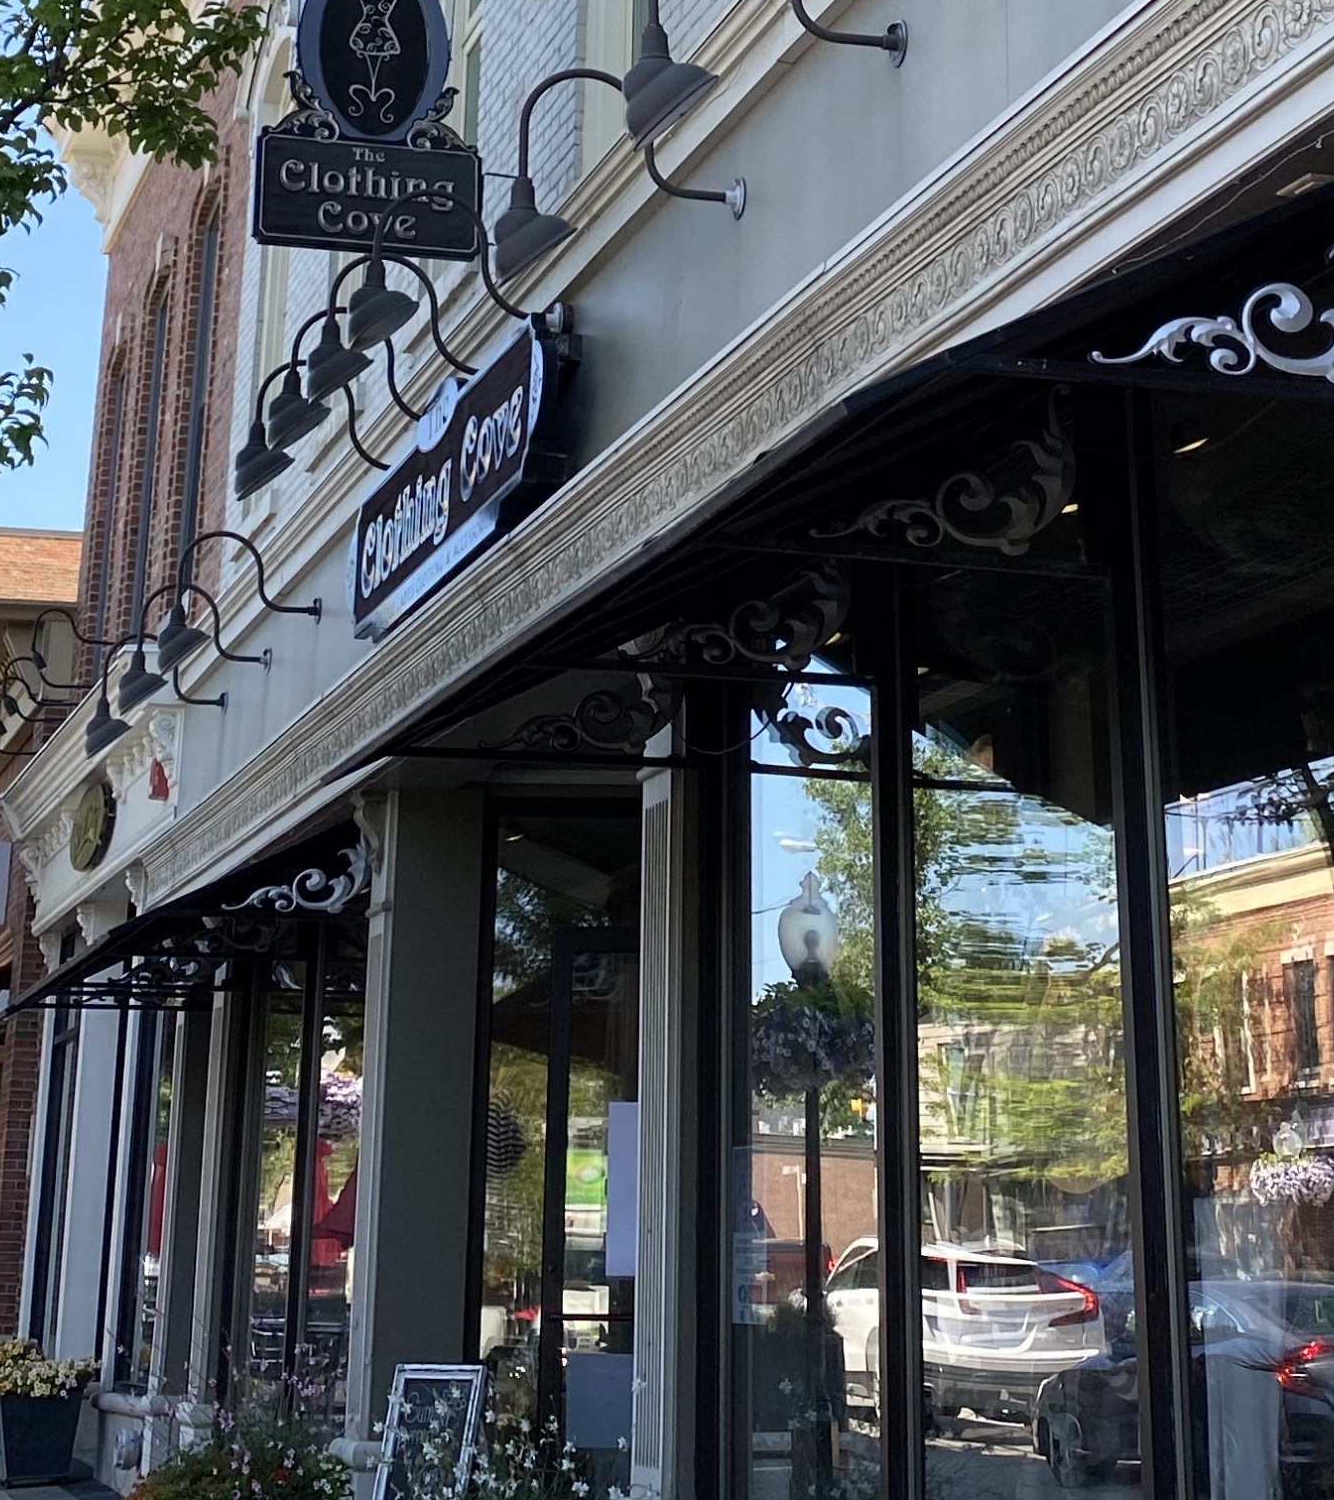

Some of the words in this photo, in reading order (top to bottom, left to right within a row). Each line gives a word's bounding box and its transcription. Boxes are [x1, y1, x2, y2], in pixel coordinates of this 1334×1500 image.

[352, 146, 386, 163] The
[279, 158, 455, 212] Clothing
[317, 199, 417, 239] Cove
[427, 395, 451, 440] The
[361, 457, 452, 599] Clothing
[460, 384, 523, 502] Cove
